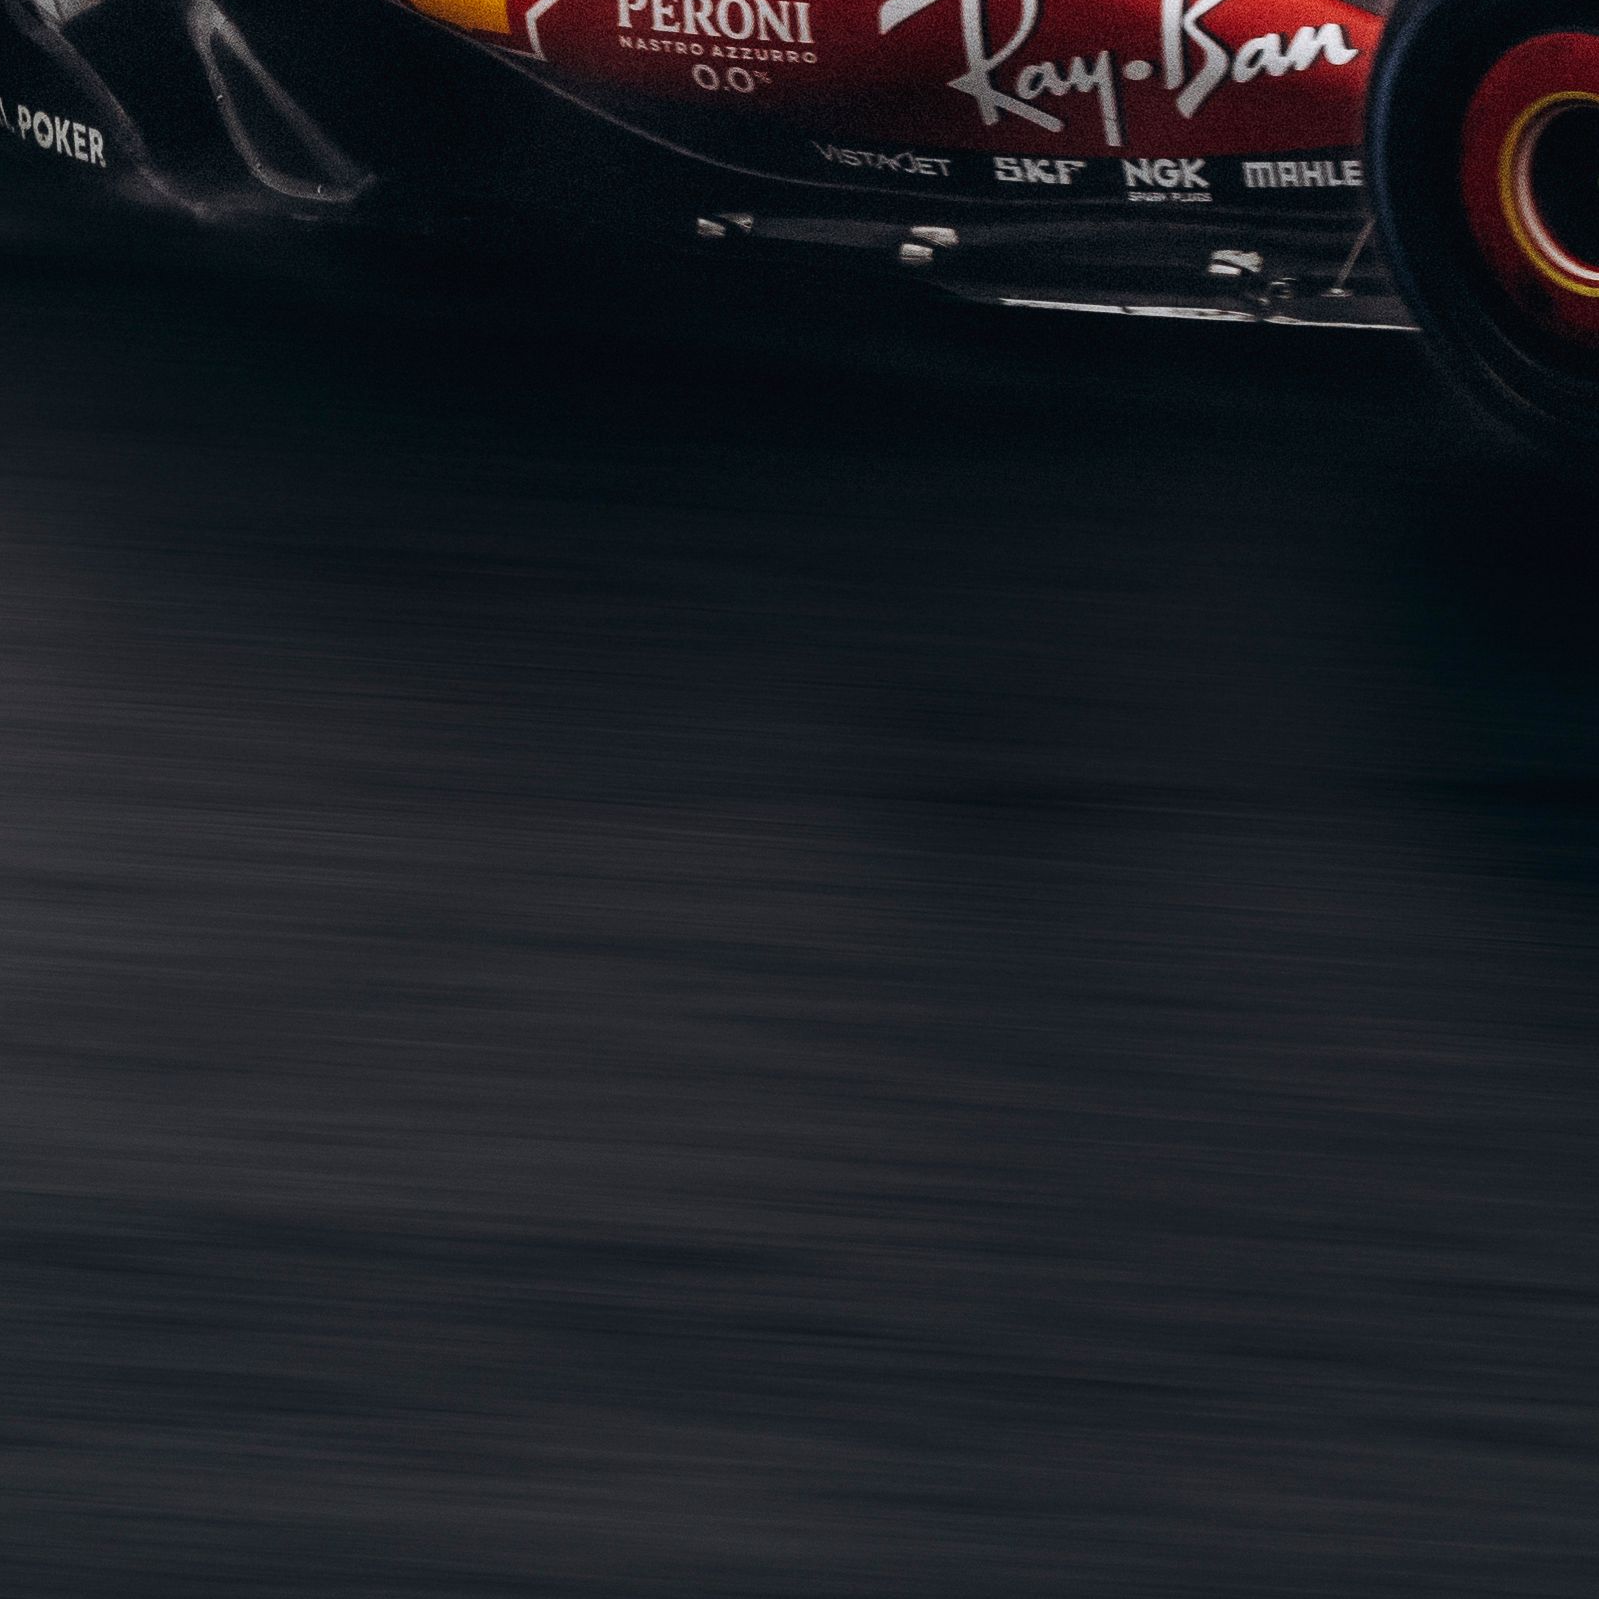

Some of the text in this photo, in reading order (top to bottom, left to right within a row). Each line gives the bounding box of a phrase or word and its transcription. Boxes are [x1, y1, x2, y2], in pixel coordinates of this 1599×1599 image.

[618, 35, 818, 64] NASTRO AZZURRO
[17, 104, 107, 168] POKER
[992, 156, 1087, 185] SKF
[1121, 158, 1211, 188] NGK
[1242, 160, 1365, 188] MAHLE
